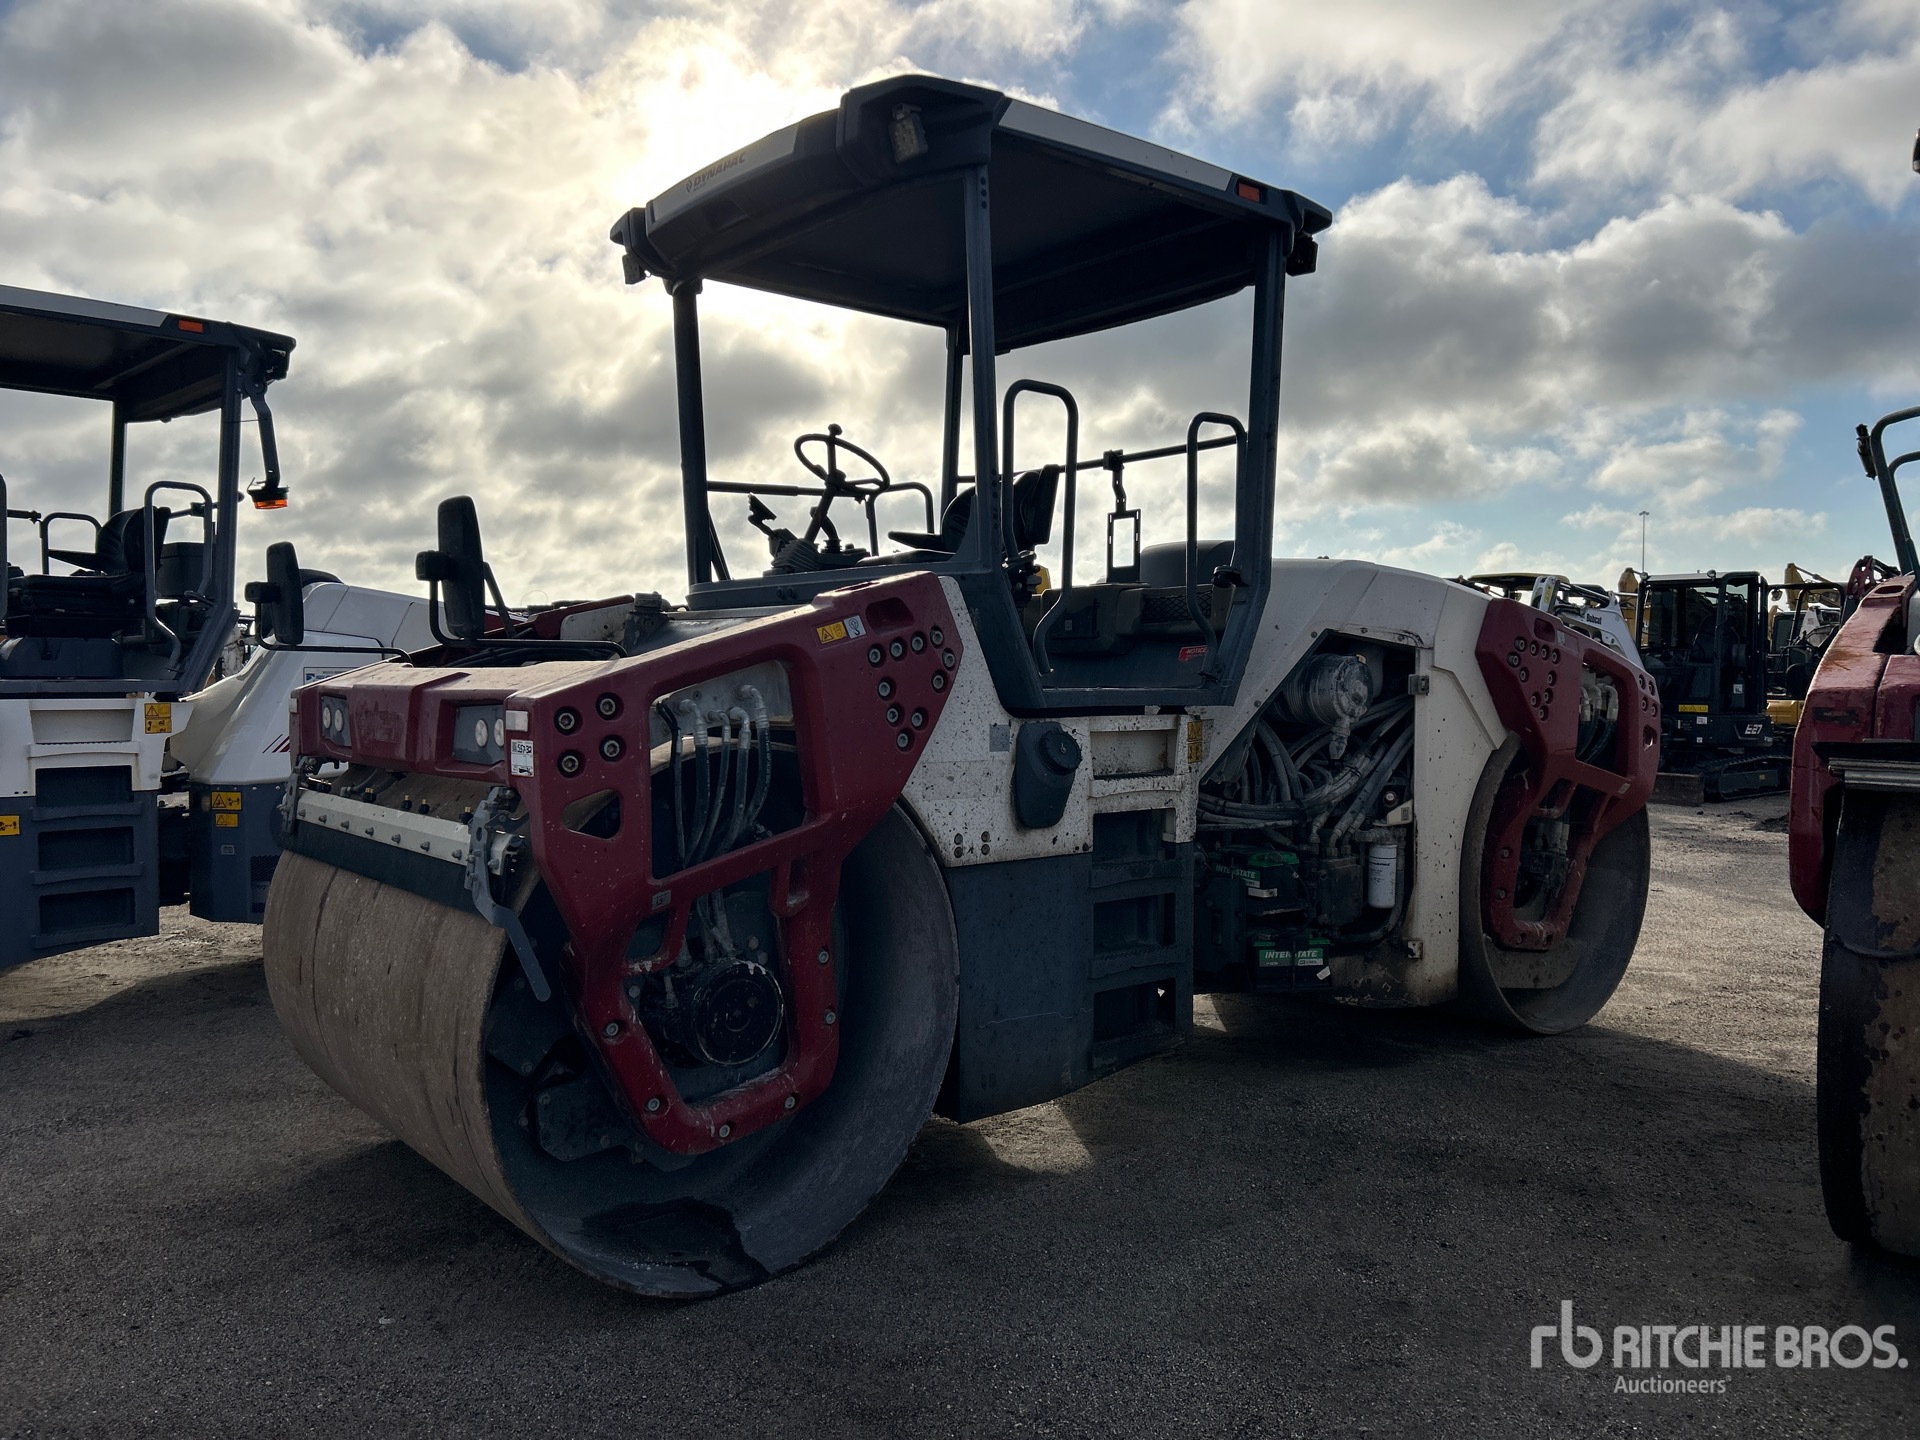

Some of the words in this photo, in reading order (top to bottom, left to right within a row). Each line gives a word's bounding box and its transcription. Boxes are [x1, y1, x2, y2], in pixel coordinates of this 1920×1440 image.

[693, 152, 746, 187] DYNAPAC
[1587, 613, 1602, 625] Bobcat
[1745, 724, 1762, 734] E27
[1215, 864, 1256, 879] INTESTATE
